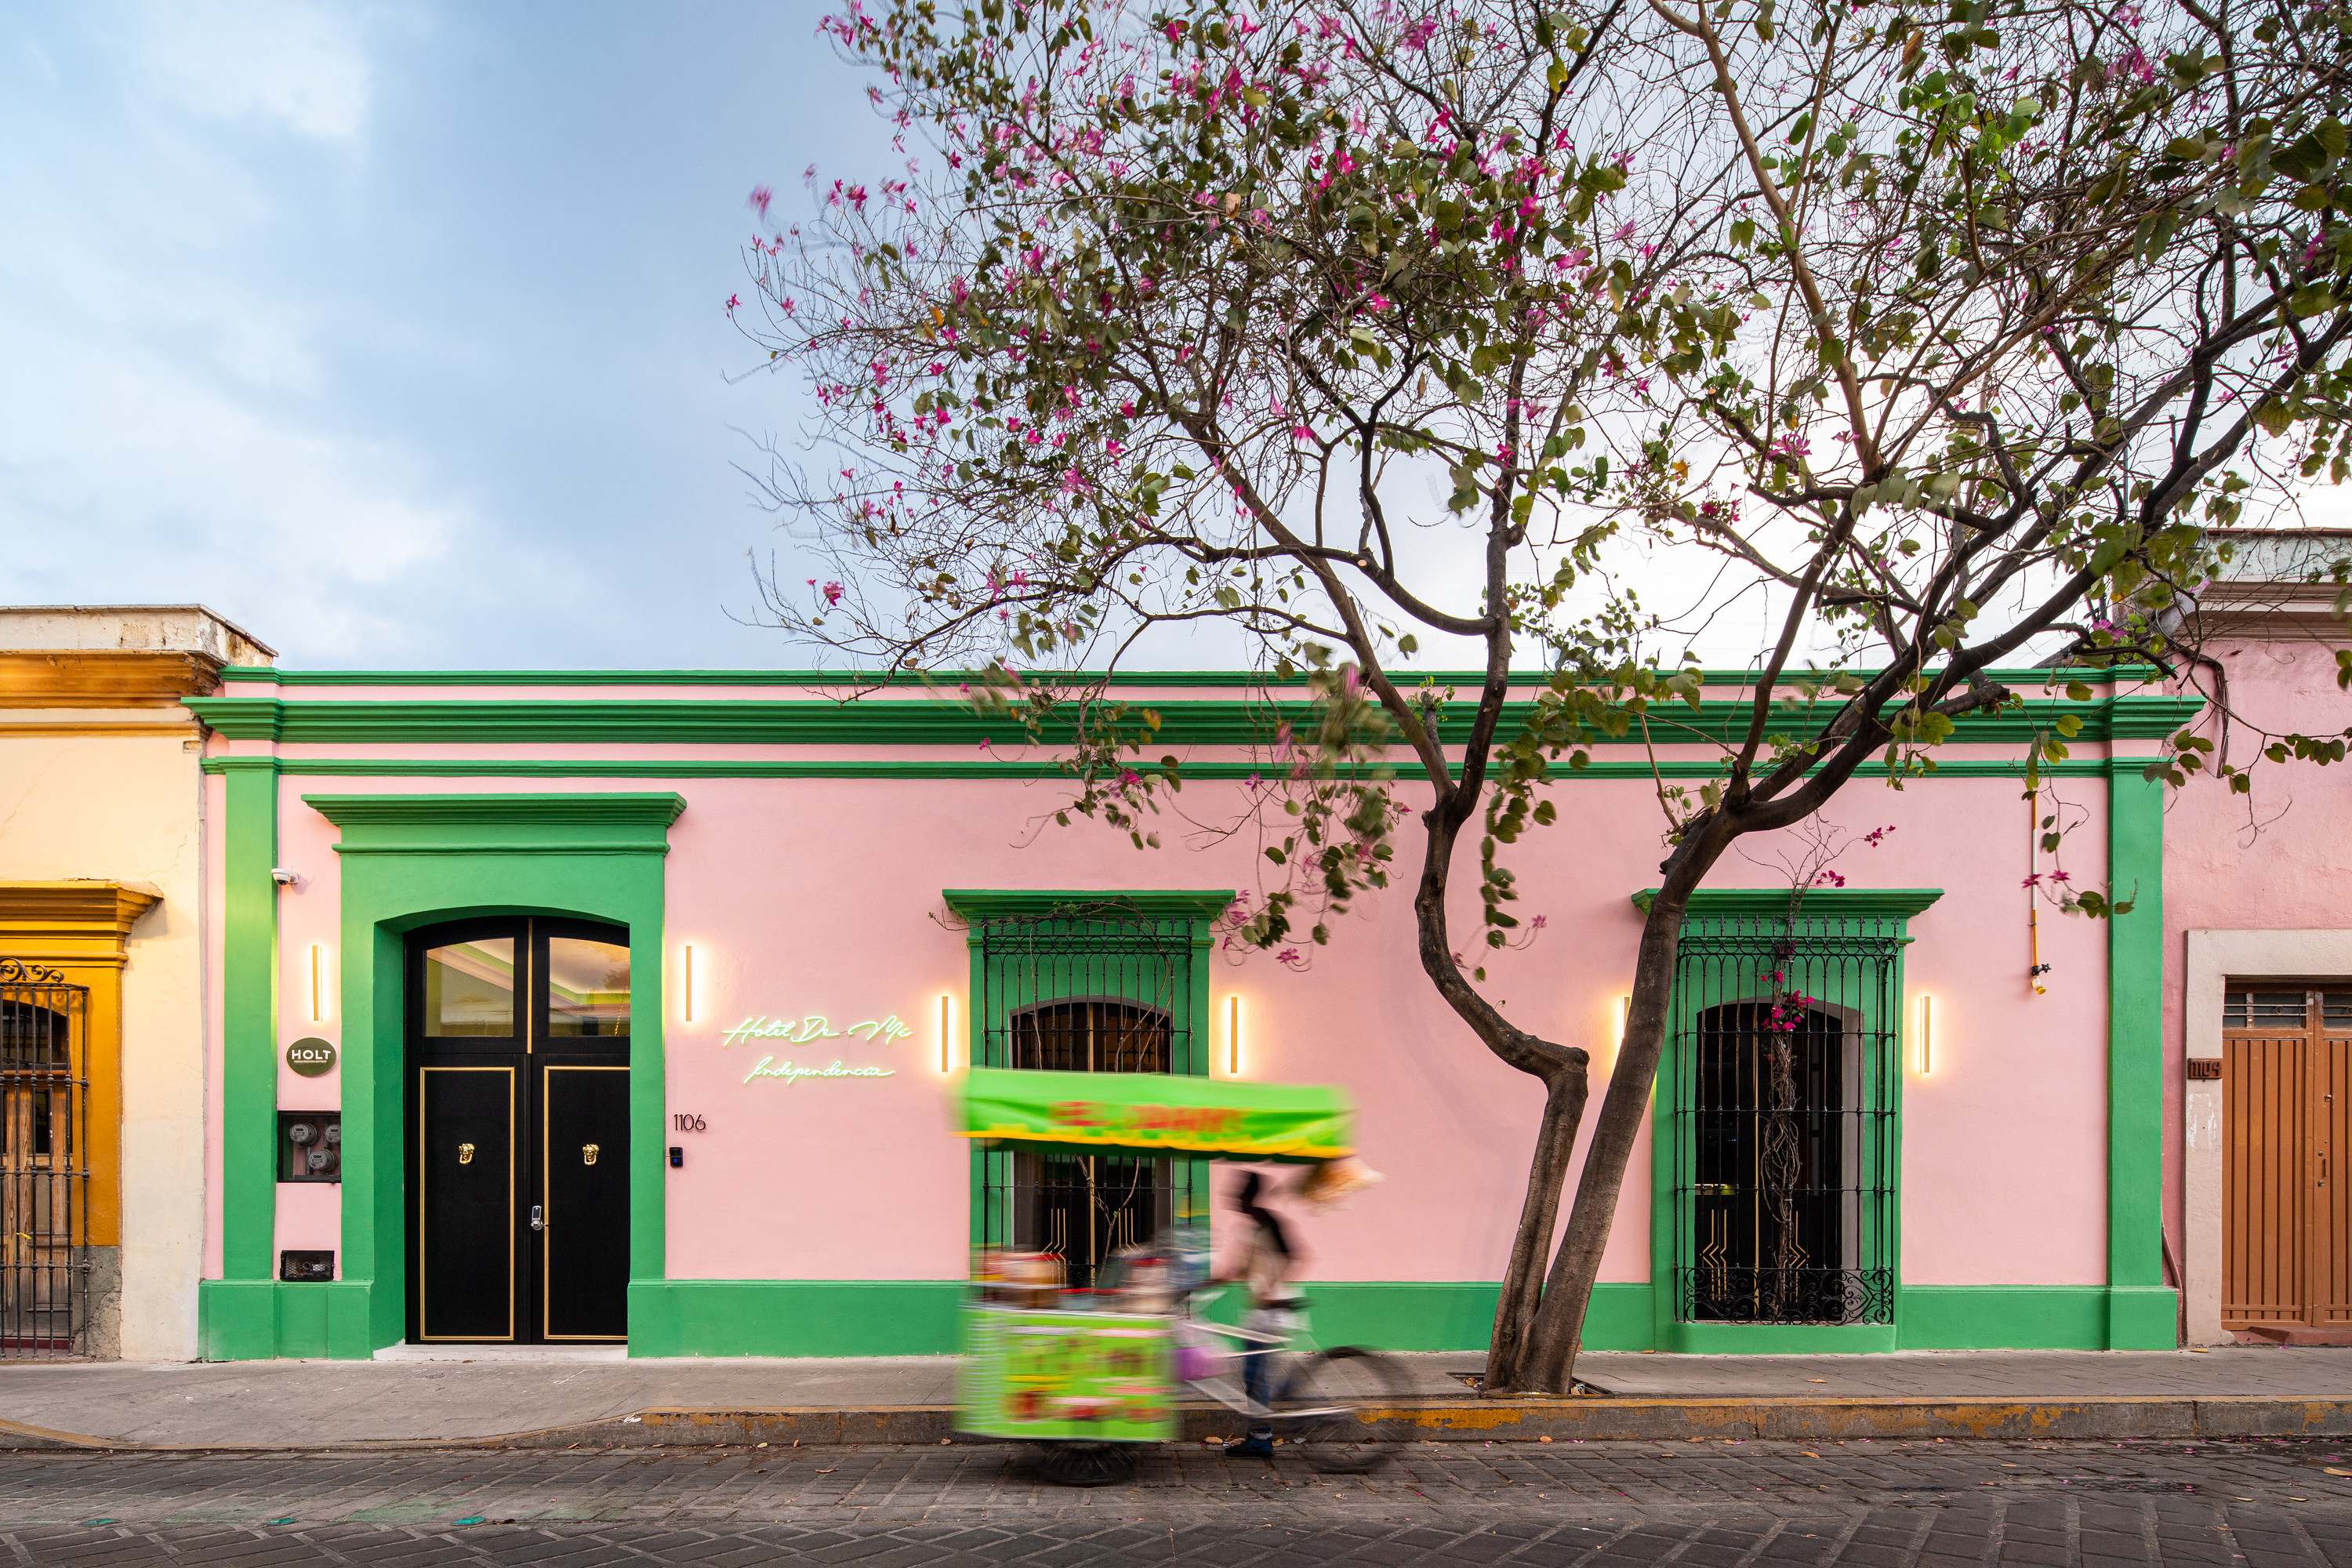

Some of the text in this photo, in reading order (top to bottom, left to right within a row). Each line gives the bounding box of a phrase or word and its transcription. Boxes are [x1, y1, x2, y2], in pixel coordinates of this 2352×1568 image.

[721, 1014, 913, 1047] Hotel De Mi
[291, 1049, 331, 1060] HOLT
[742, 1055, 895, 1085] Independencia
[673, 1113, 706, 1131] 1106
